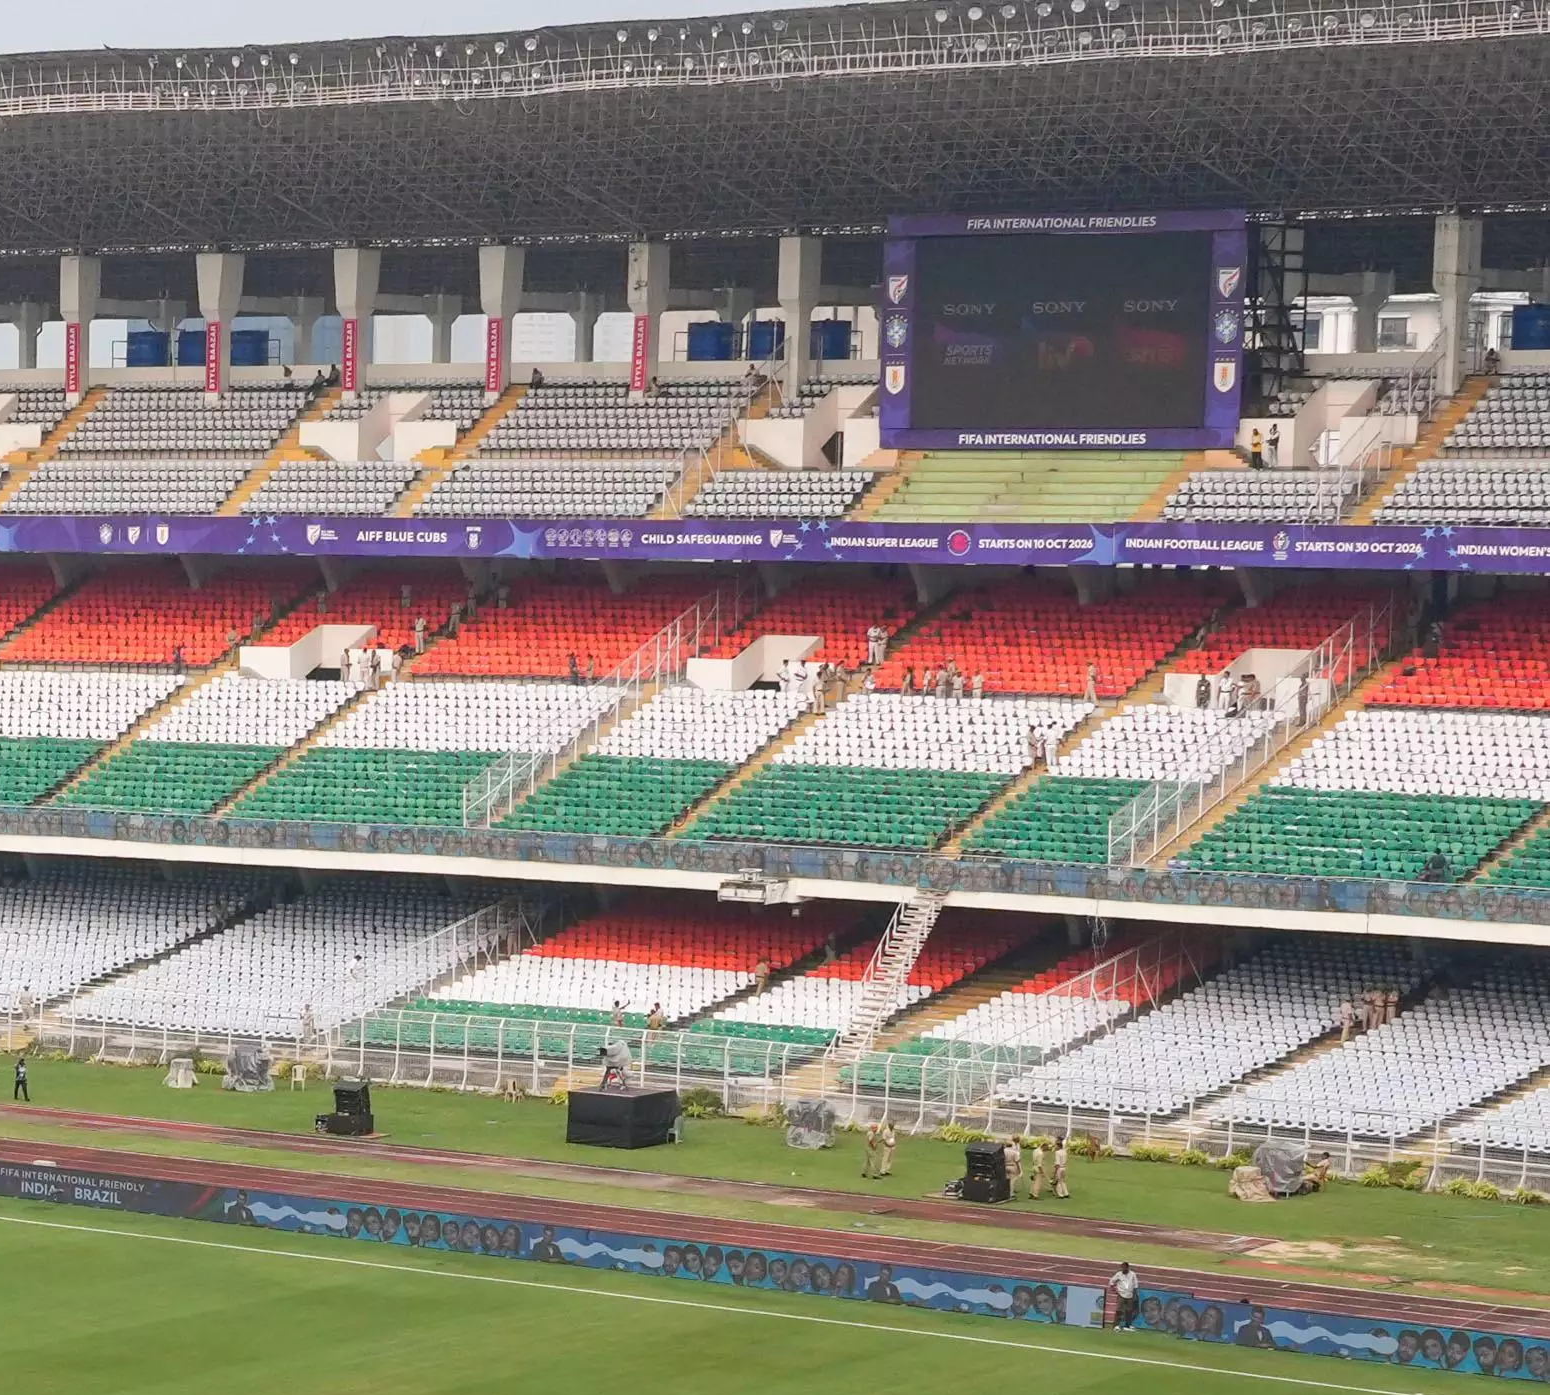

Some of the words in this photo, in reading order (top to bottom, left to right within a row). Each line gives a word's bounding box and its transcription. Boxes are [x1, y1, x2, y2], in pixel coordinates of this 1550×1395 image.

[967, 218, 990, 229] FIFA
[993, 217, 1086, 229] INTERNATIONAL
[1088, 216, 1156, 228] FRIENDLIES
[943, 304, 996, 315] SONY
[1033, 302, 1086, 313] SONY
[1124, 300, 1178, 312] SONY
[947, 345, 994, 356] SPORTS
[958, 434, 983, 444] FIFA
[984, 433, 1077, 445] INTERNATIONAL
[1079, 433, 1146, 445] FRIENDLIES
[356, 530, 382, 541] AIFF
[384, 531, 414, 542] BLUE
[416, 531, 447, 543] CUBS
[641, 534, 674, 544] CHILD
[676, 534, 762, 544] SAFEGUARDING
[830, 537, 865, 546] INDIAN
[866, 537, 897, 547] SUPER
[898, 538, 938, 548] LEAGUE
[978, 538, 1015, 548] STARTS
[1016, 539, 1032, 548] ON
[1033, 539, 1044, 549] 10
[1045, 538, 1068, 549] OCT
[1068, 539, 1093, 549] 2026
[1125, 538, 1162, 548] INDIAN
[1163, 539, 1219, 550] FOOTBALL
[1220, 540, 1263, 551] LEAGUE
[1295, 541, 1334, 552] STARTS
[1335, 542, 1353, 552] ON
[1354, 542, 1369, 552] 30
[1370, 542, 1394, 553] OCT
[1395, 543, 1423, 554] 2026
[1456, 544, 1497, 555] INDIAN
[0, 1167, 19, 1177] FIFA
[22, 1171, 96, 1187] INTERNATIONAL
[100, 1179, 145, 1192] FRIENDLY
[74, 1187, 121, 1204] BRAZIL
